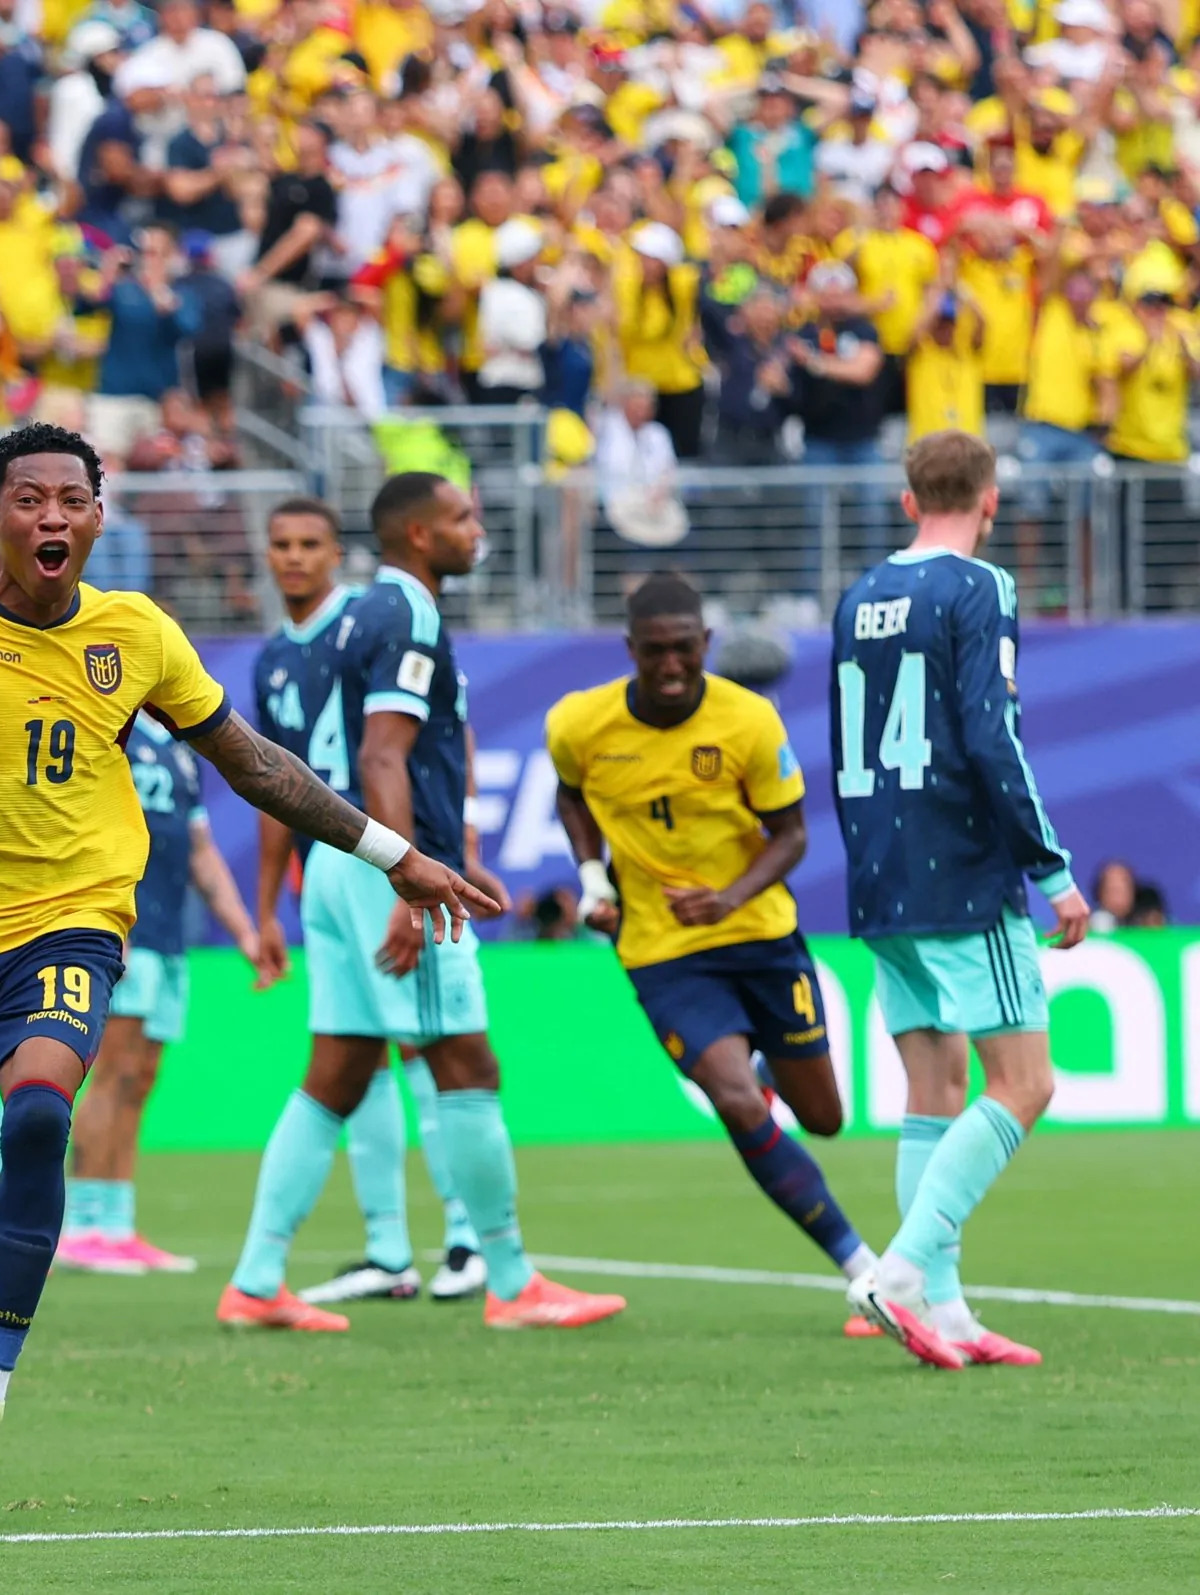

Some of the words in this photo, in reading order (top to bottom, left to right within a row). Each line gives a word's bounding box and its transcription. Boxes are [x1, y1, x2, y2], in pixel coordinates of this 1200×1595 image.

[25, 719, 76, 785] 19
[308, 673, 350, 791] 4
[837, 652, 932, 798] 14
[650, 795, 674, 830] 4
[37, 965, 91, 1014] 19
[792, 972, 817, 1026] 4
[27, 1009, 88, 1035] marathon
